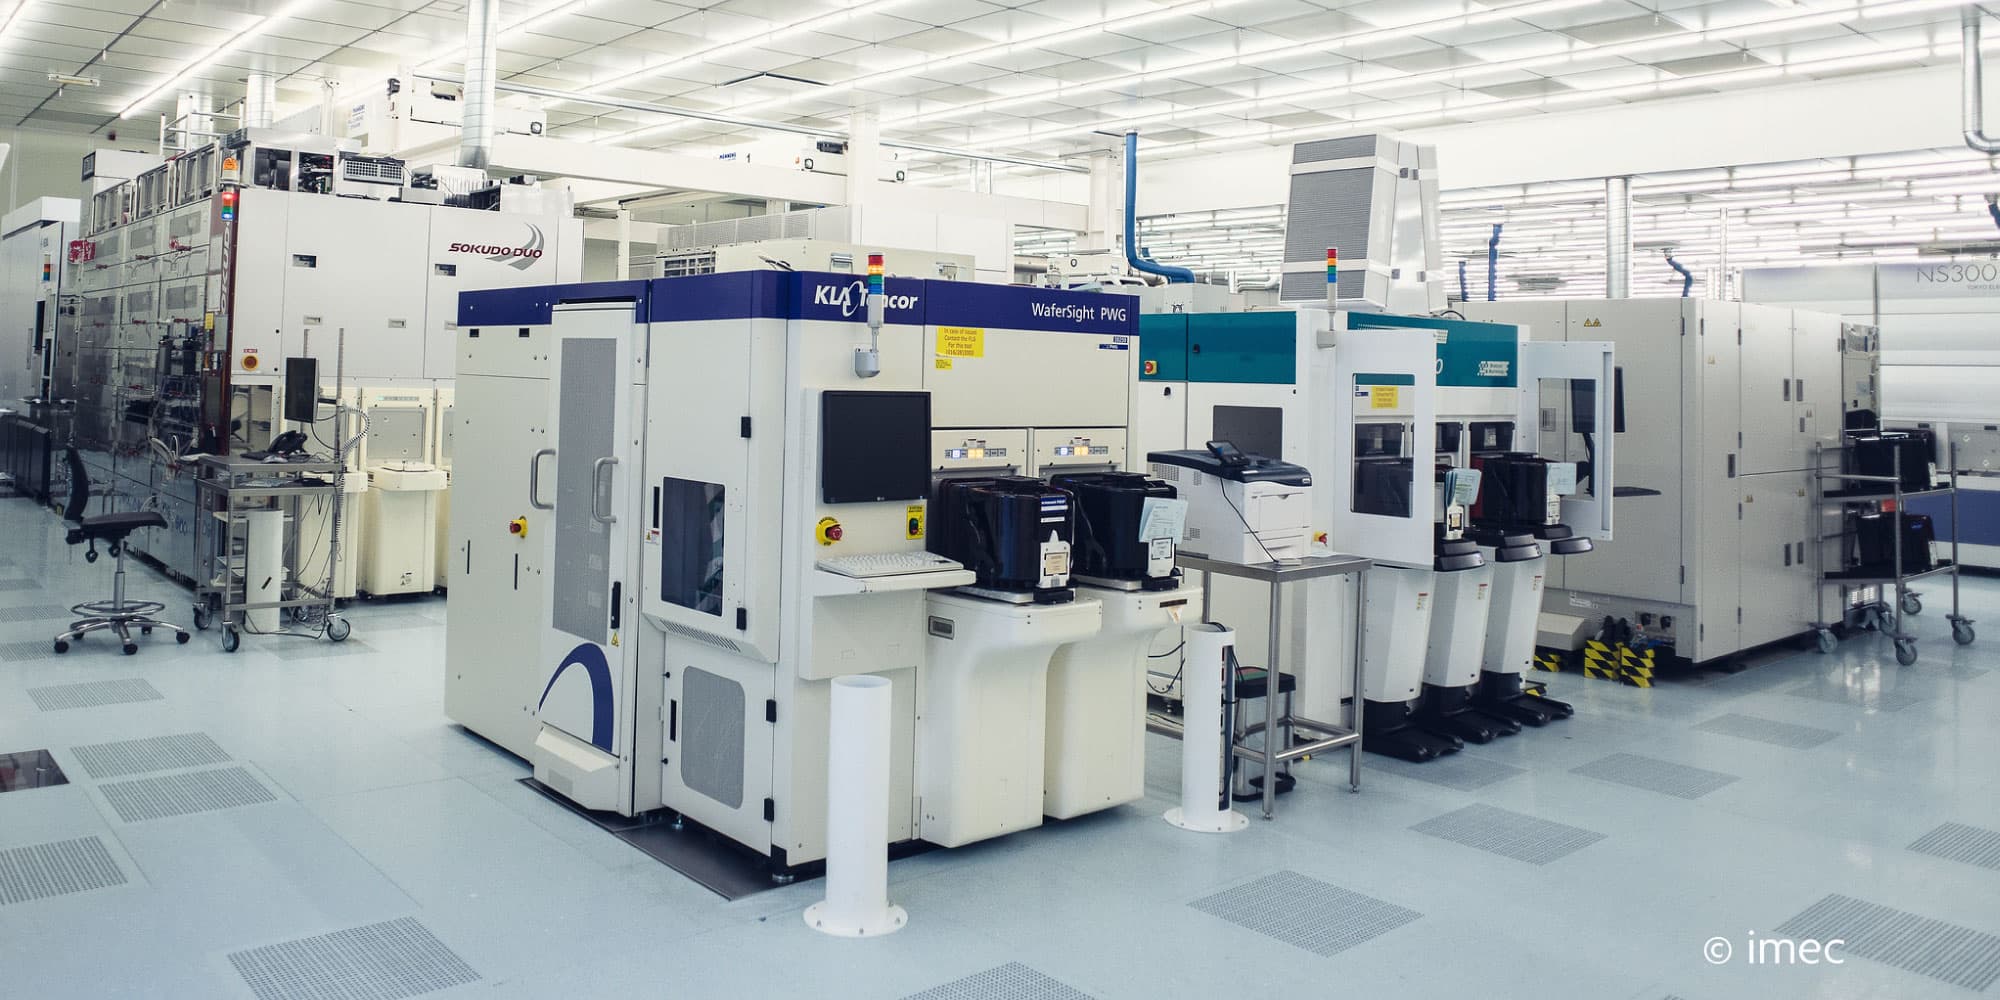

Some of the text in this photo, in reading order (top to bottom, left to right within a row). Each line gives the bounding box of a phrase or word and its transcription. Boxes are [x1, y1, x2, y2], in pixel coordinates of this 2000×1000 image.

[448, 243, 543, 258] SOKUDO DUO
[859, 287, 918, 310] Tcor
[1031, 302, 1127, 322] WaferSight PWG
